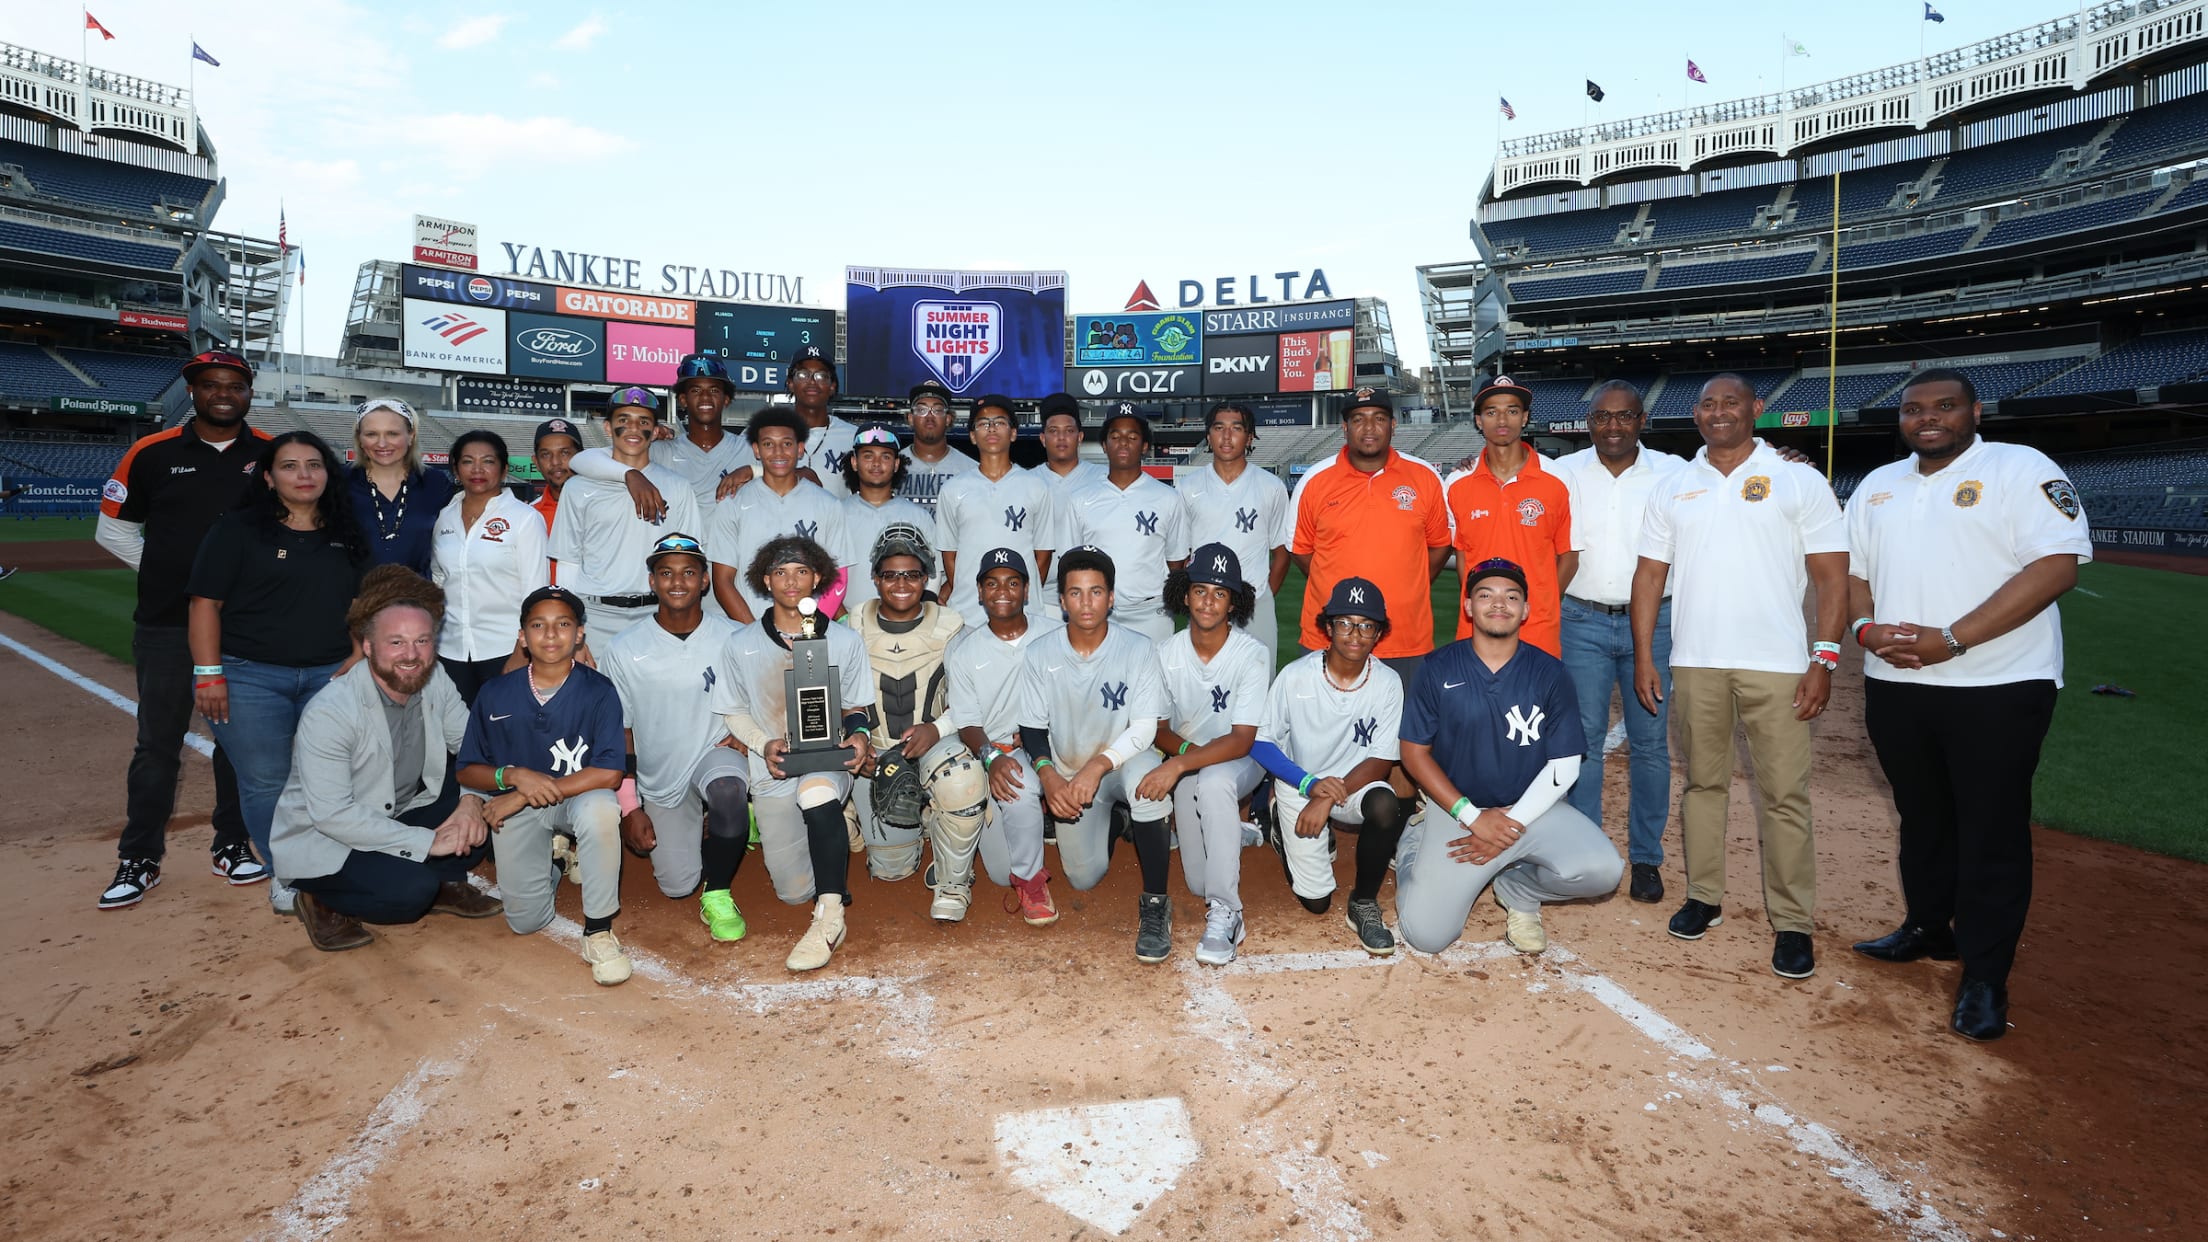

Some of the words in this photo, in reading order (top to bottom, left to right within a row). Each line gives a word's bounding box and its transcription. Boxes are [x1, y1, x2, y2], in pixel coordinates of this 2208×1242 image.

[418, 219, 475, 236] ARMITRON
[421, 248, 472, 263] ARMITRON
[500, 241, 641, 290] YANKEE
[661, 264, 804, 305] STADIUM
[418, 276, 455, 290] PEPSI
[470, 284, 491, 293] PEPSI
[1179, 268, 1332, 308] DELTA
[506, 289, 541, 301] PEPSI
[565, 292, 688, 321] GATORADE
[141, 317, 186, 329] Budweiser
[927, 312, 989, 323] SUMMER
[1206, 310, 1278, 332] STARR
[1284, 308, 1352, 322] INSURANCE
[723, 325, 729, 340] 1
[801, 330, 810, 344] 3
[926, 324, 989, 339] NIGHT
[531, 331, 582, 354] Ford
[763, 337, 769, 347] 5
[926, 340, 989, 354] LIGHTS
[1283, 337, 1307, 347] This
[405, 350, 436, 360] BANK
[439, 353, 452, 361] OF
[455, 355, 503, 366] AMERICA
[721, 347, 729, 358] 0
[770, 350, 777, 360] 0
[807, 345, 820, 357] NY
[1283, 346, 1312, 357] Bud's
[1210, 355, 1270, 374] DKNY
[1283, 358, 1301, 368] For
[1283, 368, 1306, 378] You.
[1116, 370, 1184, 393] razr
[60, 398, 99, 410] Poland
[100, 400, 137, 415] Spring
[1119, 401, 1133, 415] NY
[1549, 421, 1573, 430] Parts
[17, 483, 98, 496] Montefiore
[1004, 505, 1027, 532] NY
[1135, 510, 1159, 536] NY
[1235, 506, 1258, 533] NY
[2122, 530, 2166, 546] STADIUM
[994, 550, 1009, 564] NY
[1212, 554, 1227, 573] NY
[1348, 586, 1365, 604] NY
[1101, 681, 1128, 711] NY
[1210, 684, 1231, 713] NY
[1353, 716, 1379, 747] NY
[1504, 704, 1545, 746] NY
[548, 735, 589, 776] NY
